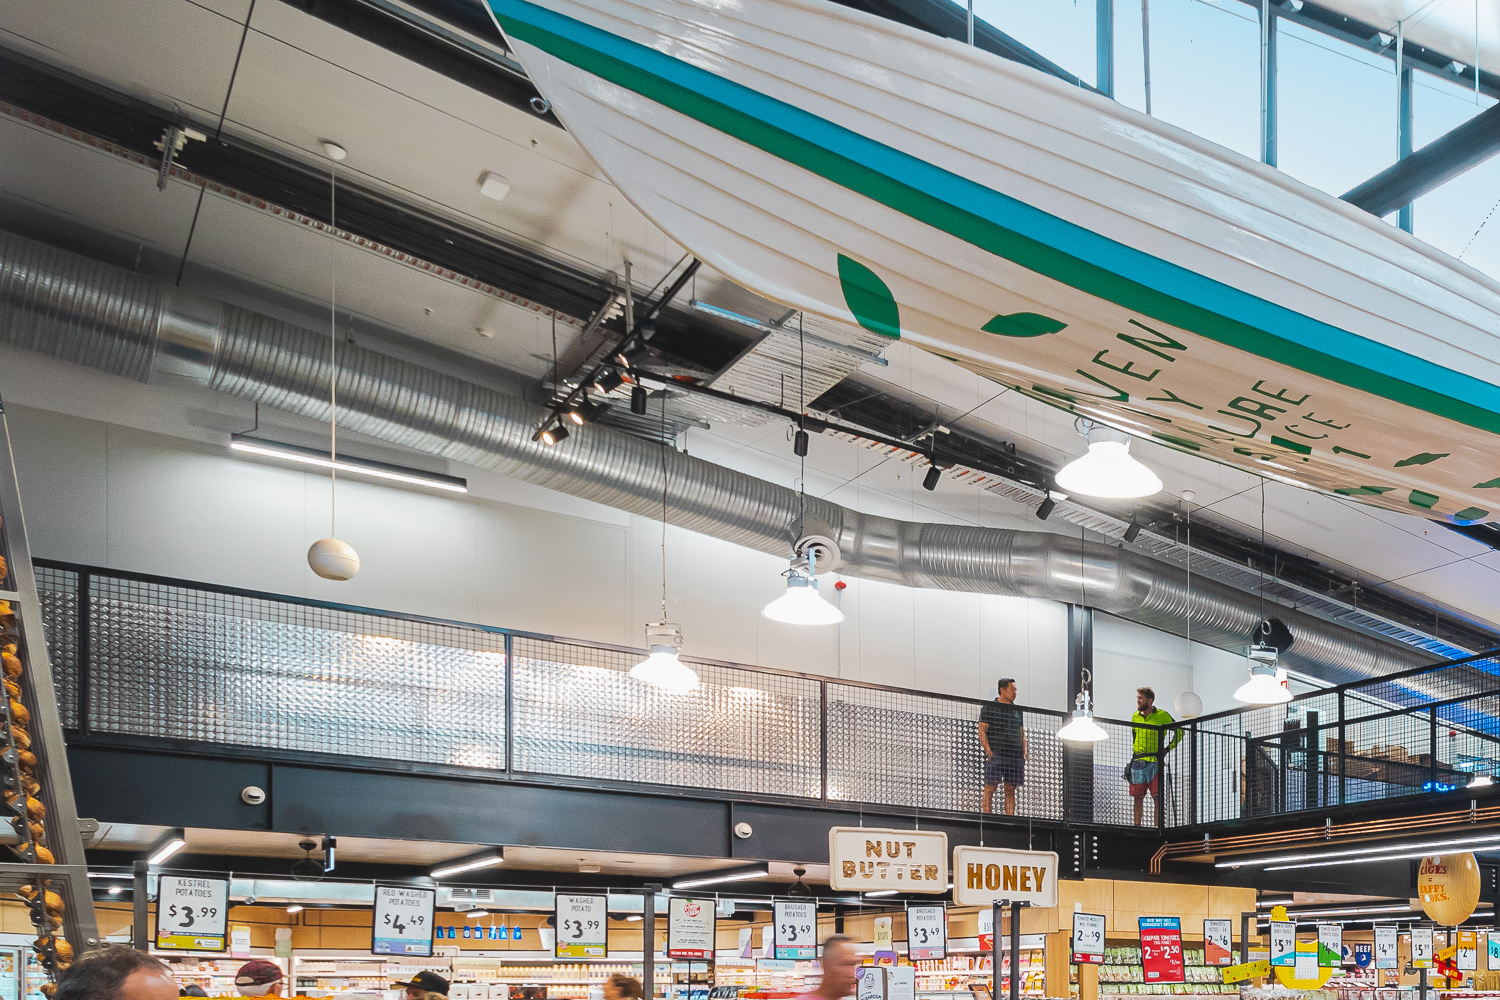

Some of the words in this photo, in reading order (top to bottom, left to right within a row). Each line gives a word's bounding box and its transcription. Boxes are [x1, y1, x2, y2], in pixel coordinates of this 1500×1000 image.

[866, 840, 916, 859] NUT
[842, 860, 939, 881] BUTTER
[177, 879, 211, 888] KESTREL
[966, 862, 1047, 893] HONEY
[175, 888, 213, 898] POTATOES
[382, 889, 396, 897] RED
[399, 890, 428, 898] WASHED
[388, 898, 421, 907] POTATOES
[784, 903, 807, 911] BRUSHED
[168, 904, 217, 928] $3.99
[383, 913, 425, 934] $4.49
[563, 919, 600, 939] $3.99
[781, 923, 811, 942] $3.49
[913, 927, 940, 944] $3.49
[1077, 930, 1083, 942] 2
[1091, 931, 1101, 942] $9
[1208, 935, 1213, 946] 2
[1219, 935, 1228, 946] $6
[1274, 938, 1292, 952] $5.99
[1144, 946, 1152, 959] 2
[1322, 942, 1338, 955] $4.99
[1355, 944, 1371, 953] BEEF
[1378, 943, 1394, 956] $4.99
[1414, 944, 1430, 957] $5.99
